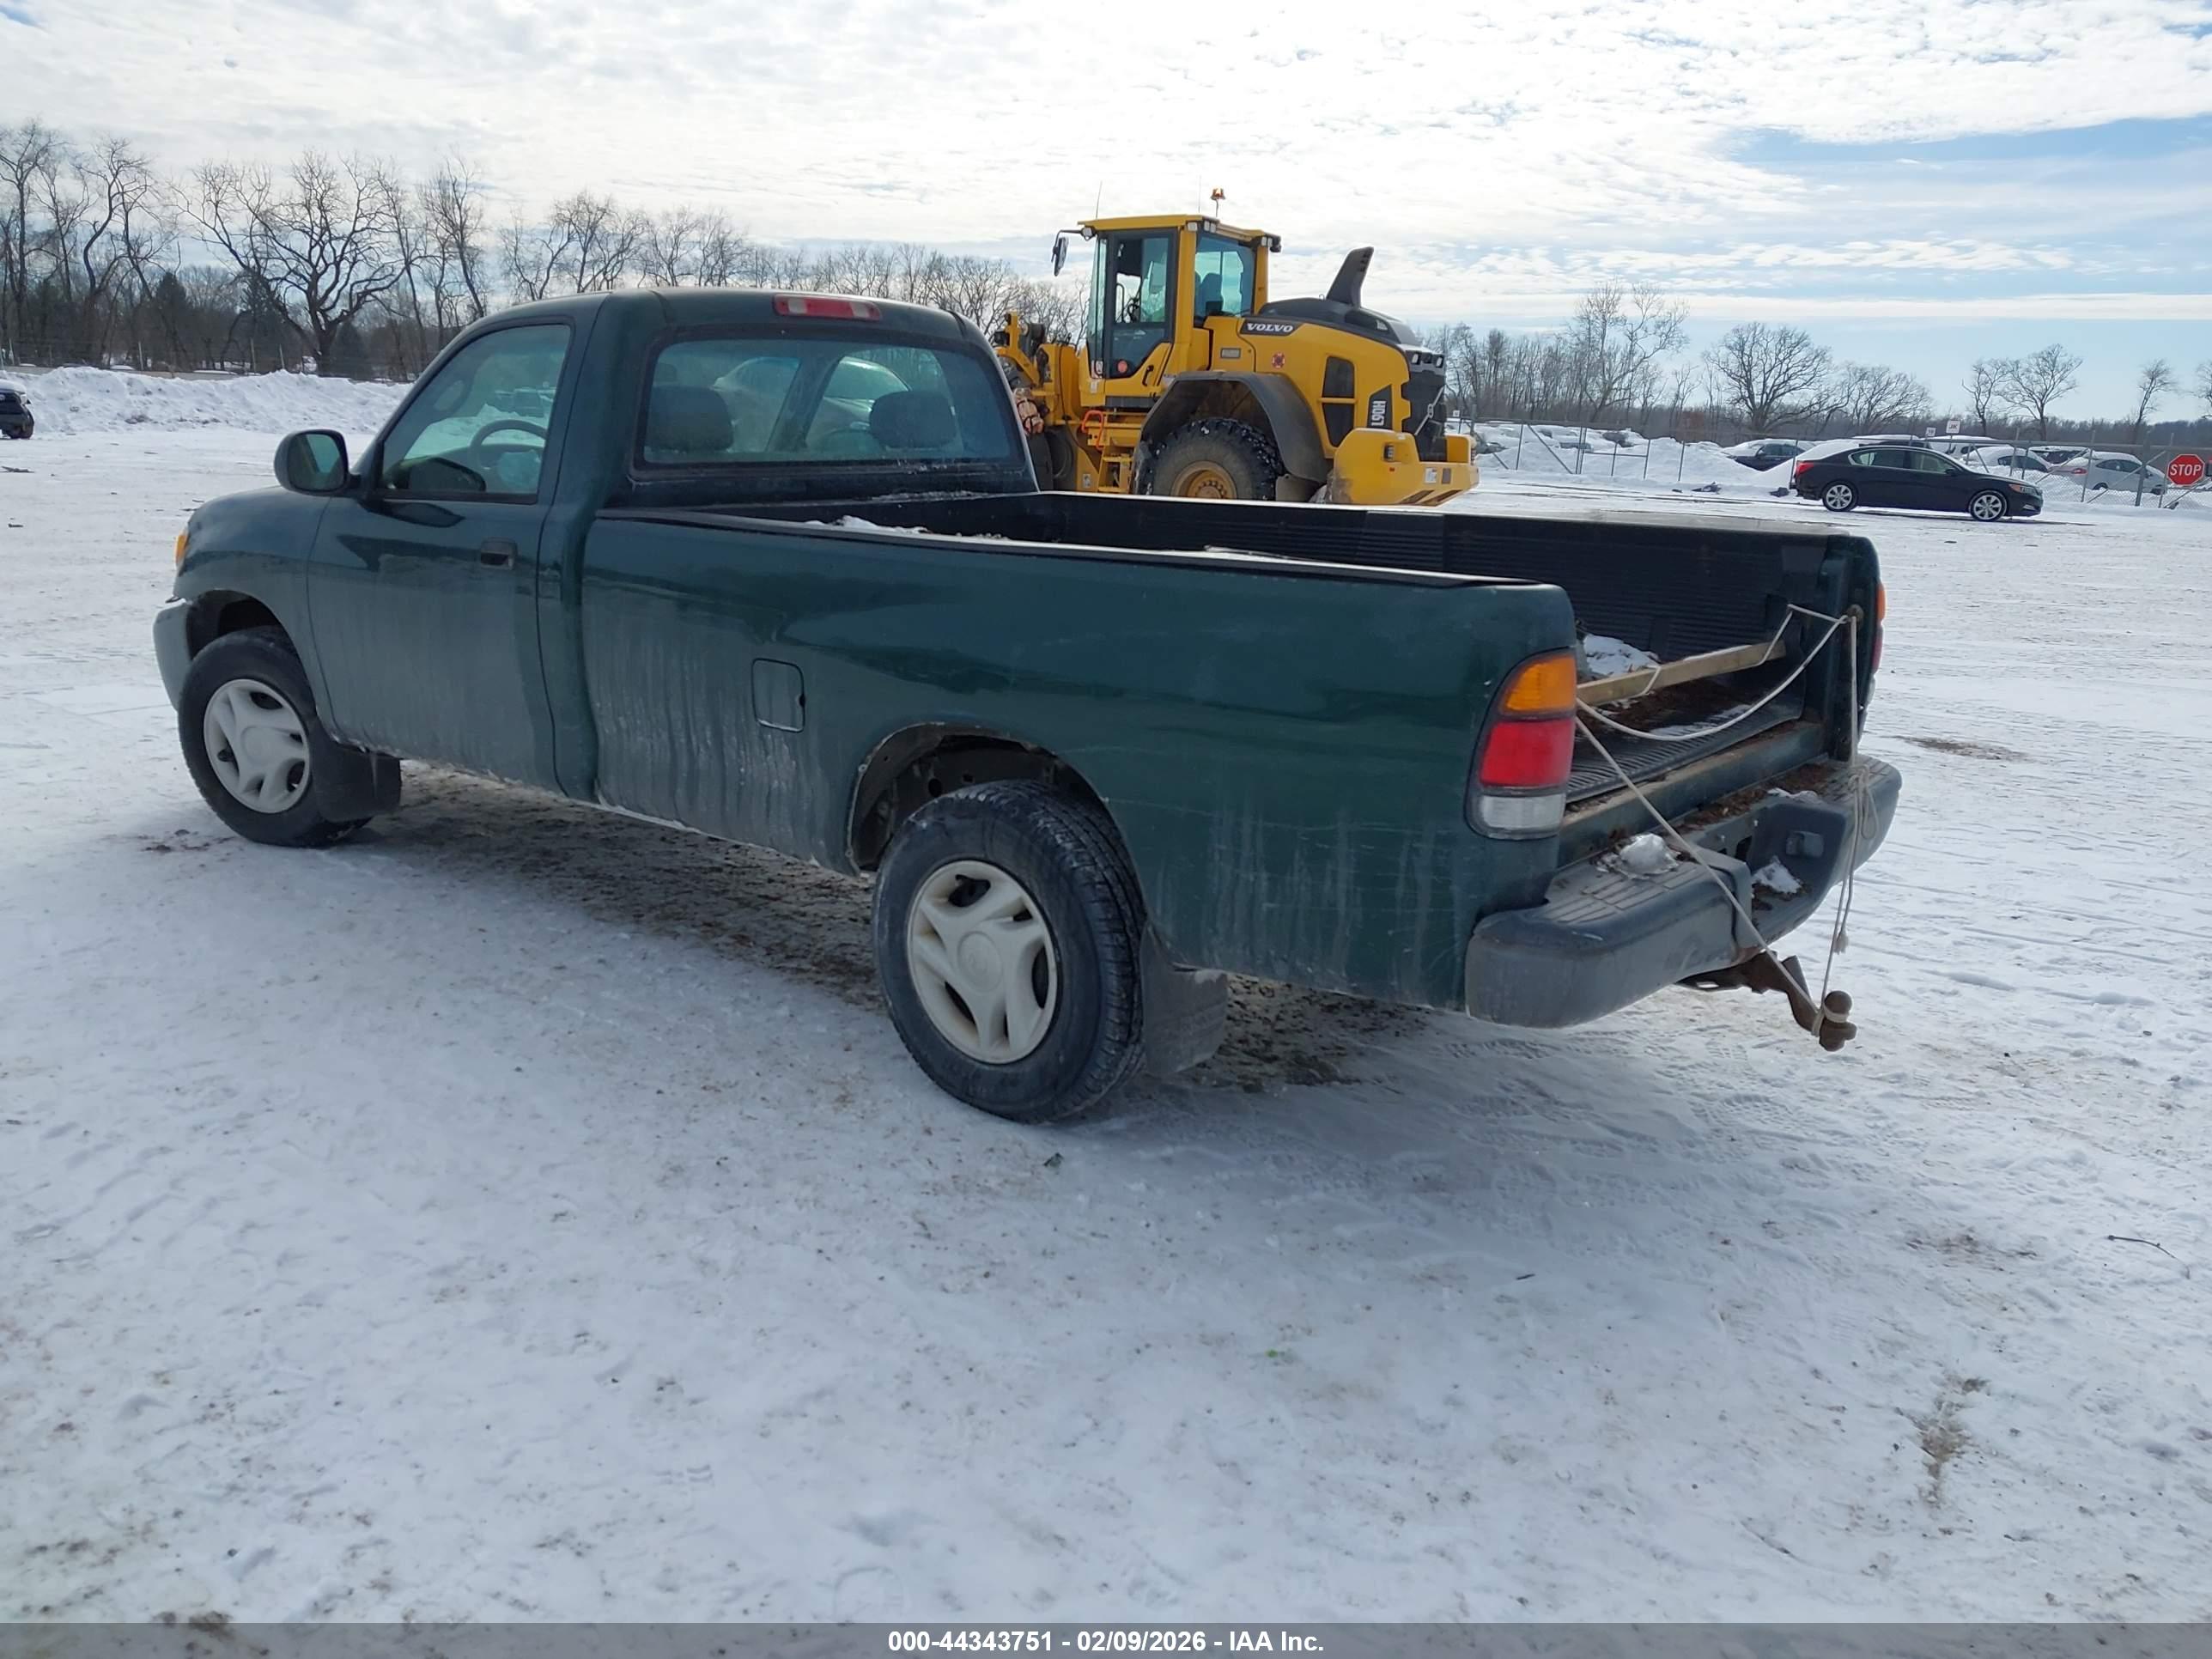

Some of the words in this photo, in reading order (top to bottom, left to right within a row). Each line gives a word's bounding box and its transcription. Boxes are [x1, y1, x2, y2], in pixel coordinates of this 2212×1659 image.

[1246, 322, 1294, 333] VOLVO
[1370, 400, 1387, 426] L90H
[2170, 464, 2202, 477] STOP
